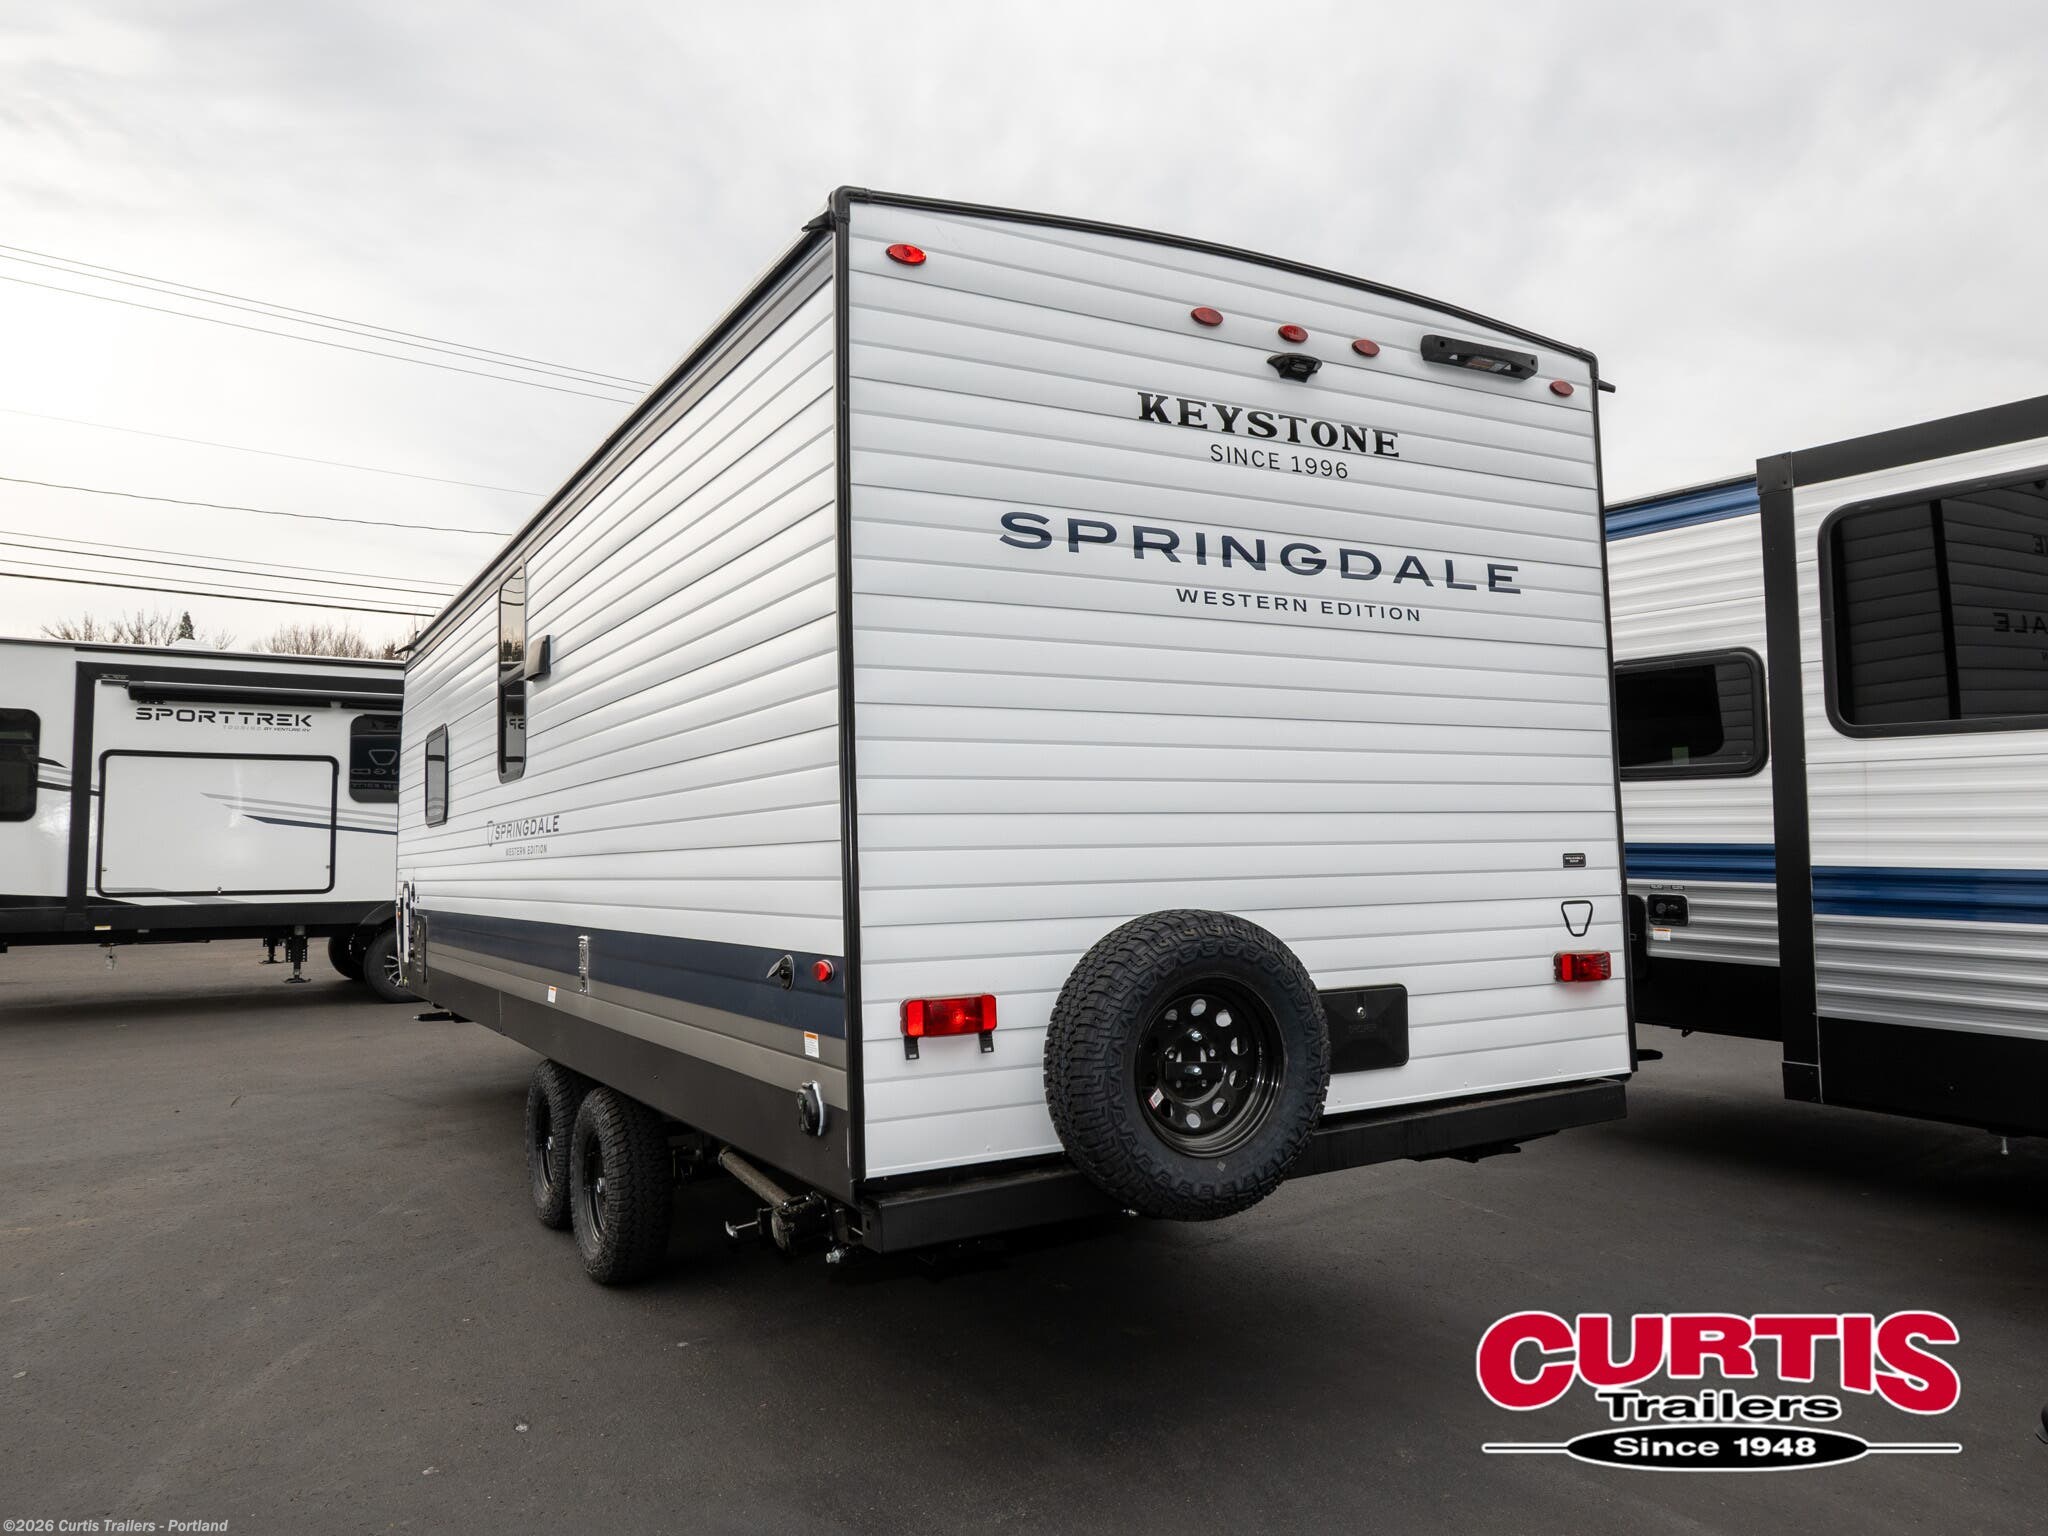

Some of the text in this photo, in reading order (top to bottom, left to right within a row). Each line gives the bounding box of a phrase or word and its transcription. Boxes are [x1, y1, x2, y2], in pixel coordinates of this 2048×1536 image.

[1137, 391, 1399, 458] KEYSTONE
[1210, 444, 1349, 479] SINCE 1996
[1000, 511, 1522, 595] SPRINGDALE
[1176, 588, 1421, 622] WESTERN EDITION
[136, 707, 312, 728] SPORTTREK
[495, 815, 560, 840] SPRINGDALE
[506, 845, 547, 856] WESTERN EDITION
